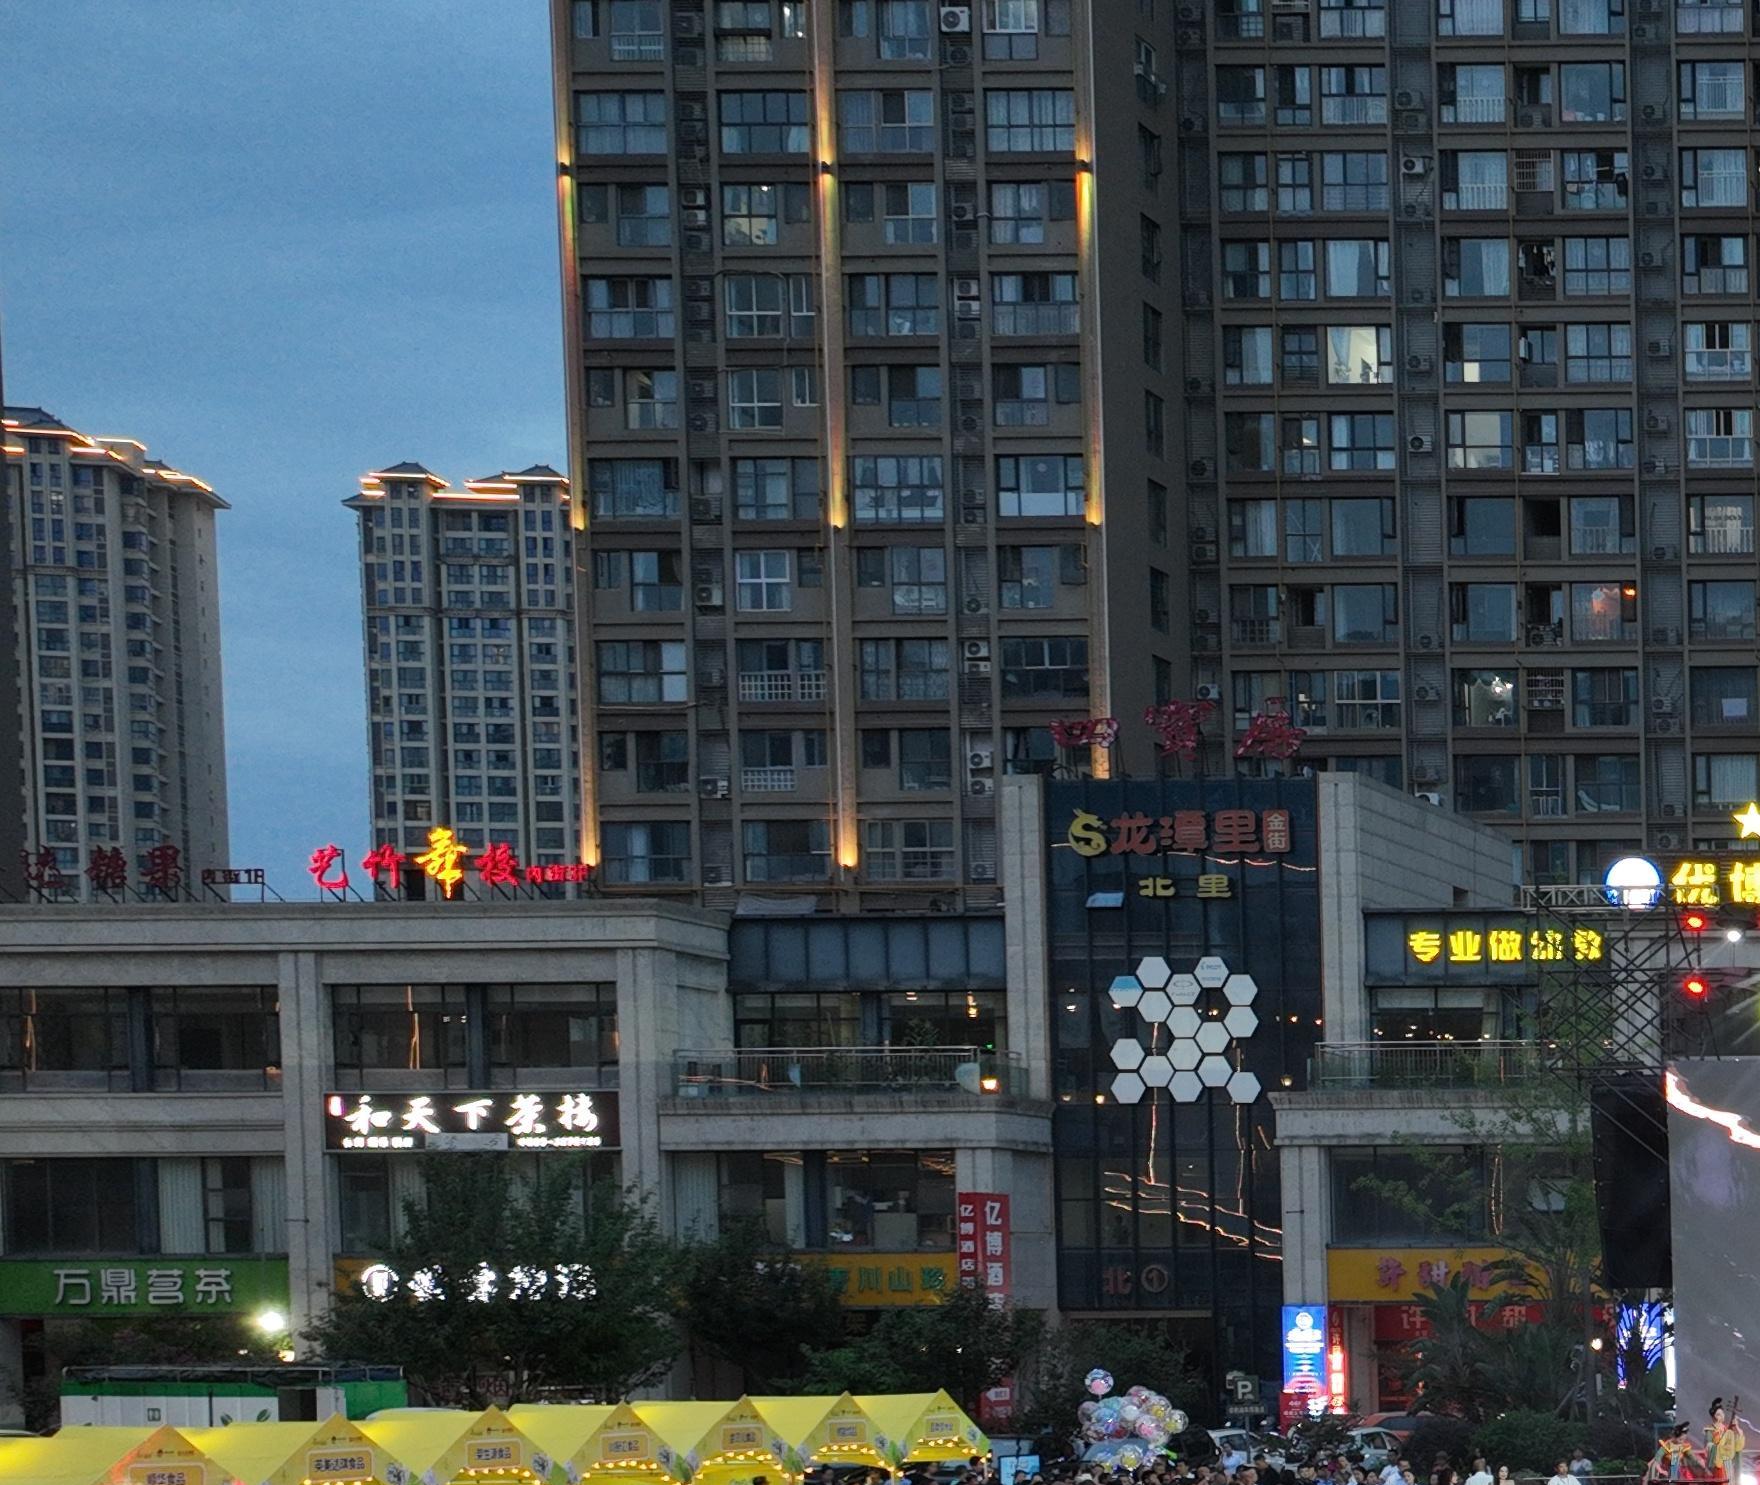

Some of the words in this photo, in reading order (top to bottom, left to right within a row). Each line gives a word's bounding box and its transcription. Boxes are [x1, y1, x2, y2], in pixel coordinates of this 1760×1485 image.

[1110, 809, 1261, 855] 龙潭里
[1138, 874, 1232, 898] 北里
[53, 1267, 233, 1305] 万鼎茗茶
[1237, 1381, 1253, 1400] P
